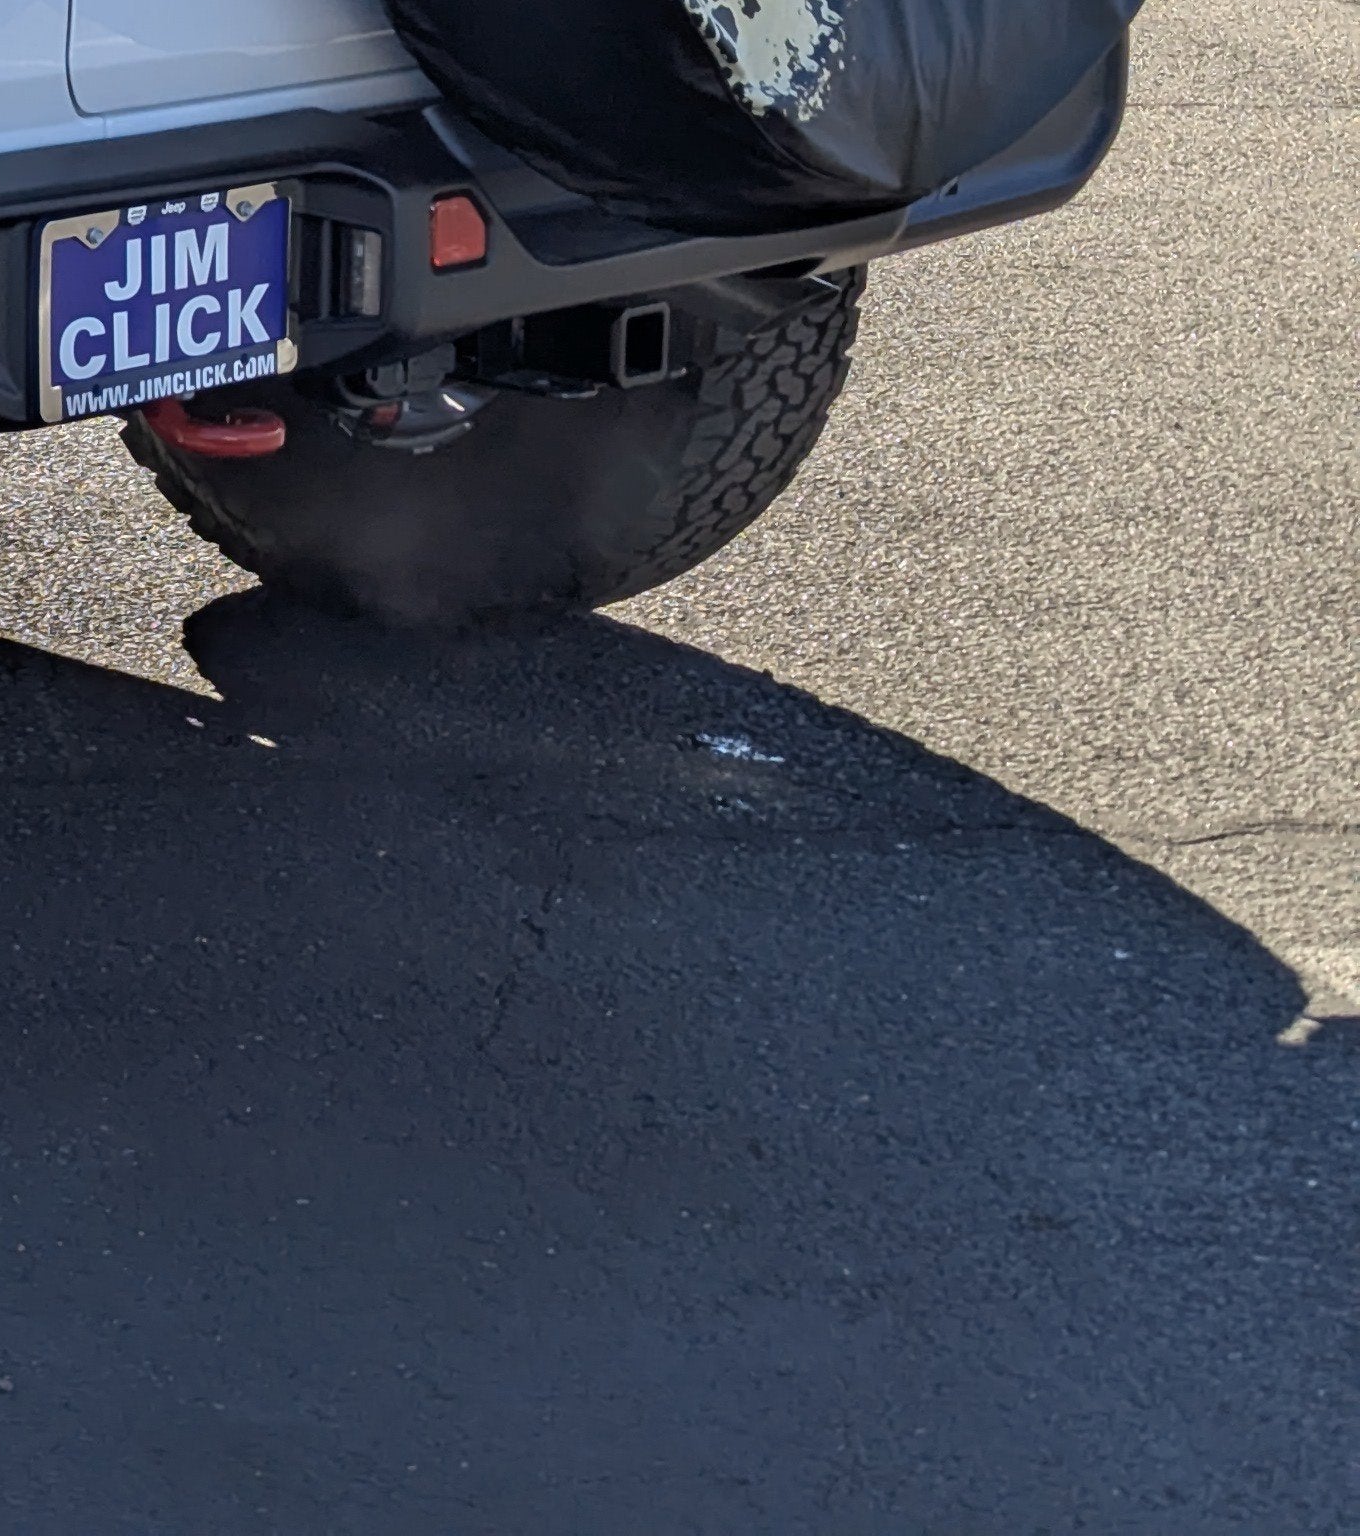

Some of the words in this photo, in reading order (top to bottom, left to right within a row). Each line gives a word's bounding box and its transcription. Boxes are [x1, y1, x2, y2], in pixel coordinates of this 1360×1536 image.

[161, 201, 186, 215] Jeep
[103, 221, 230, 302] JIM
[59, 282, 271, 381] CLICK
[65, 352, 275, 417] WWW.JIMCLICK.COM
